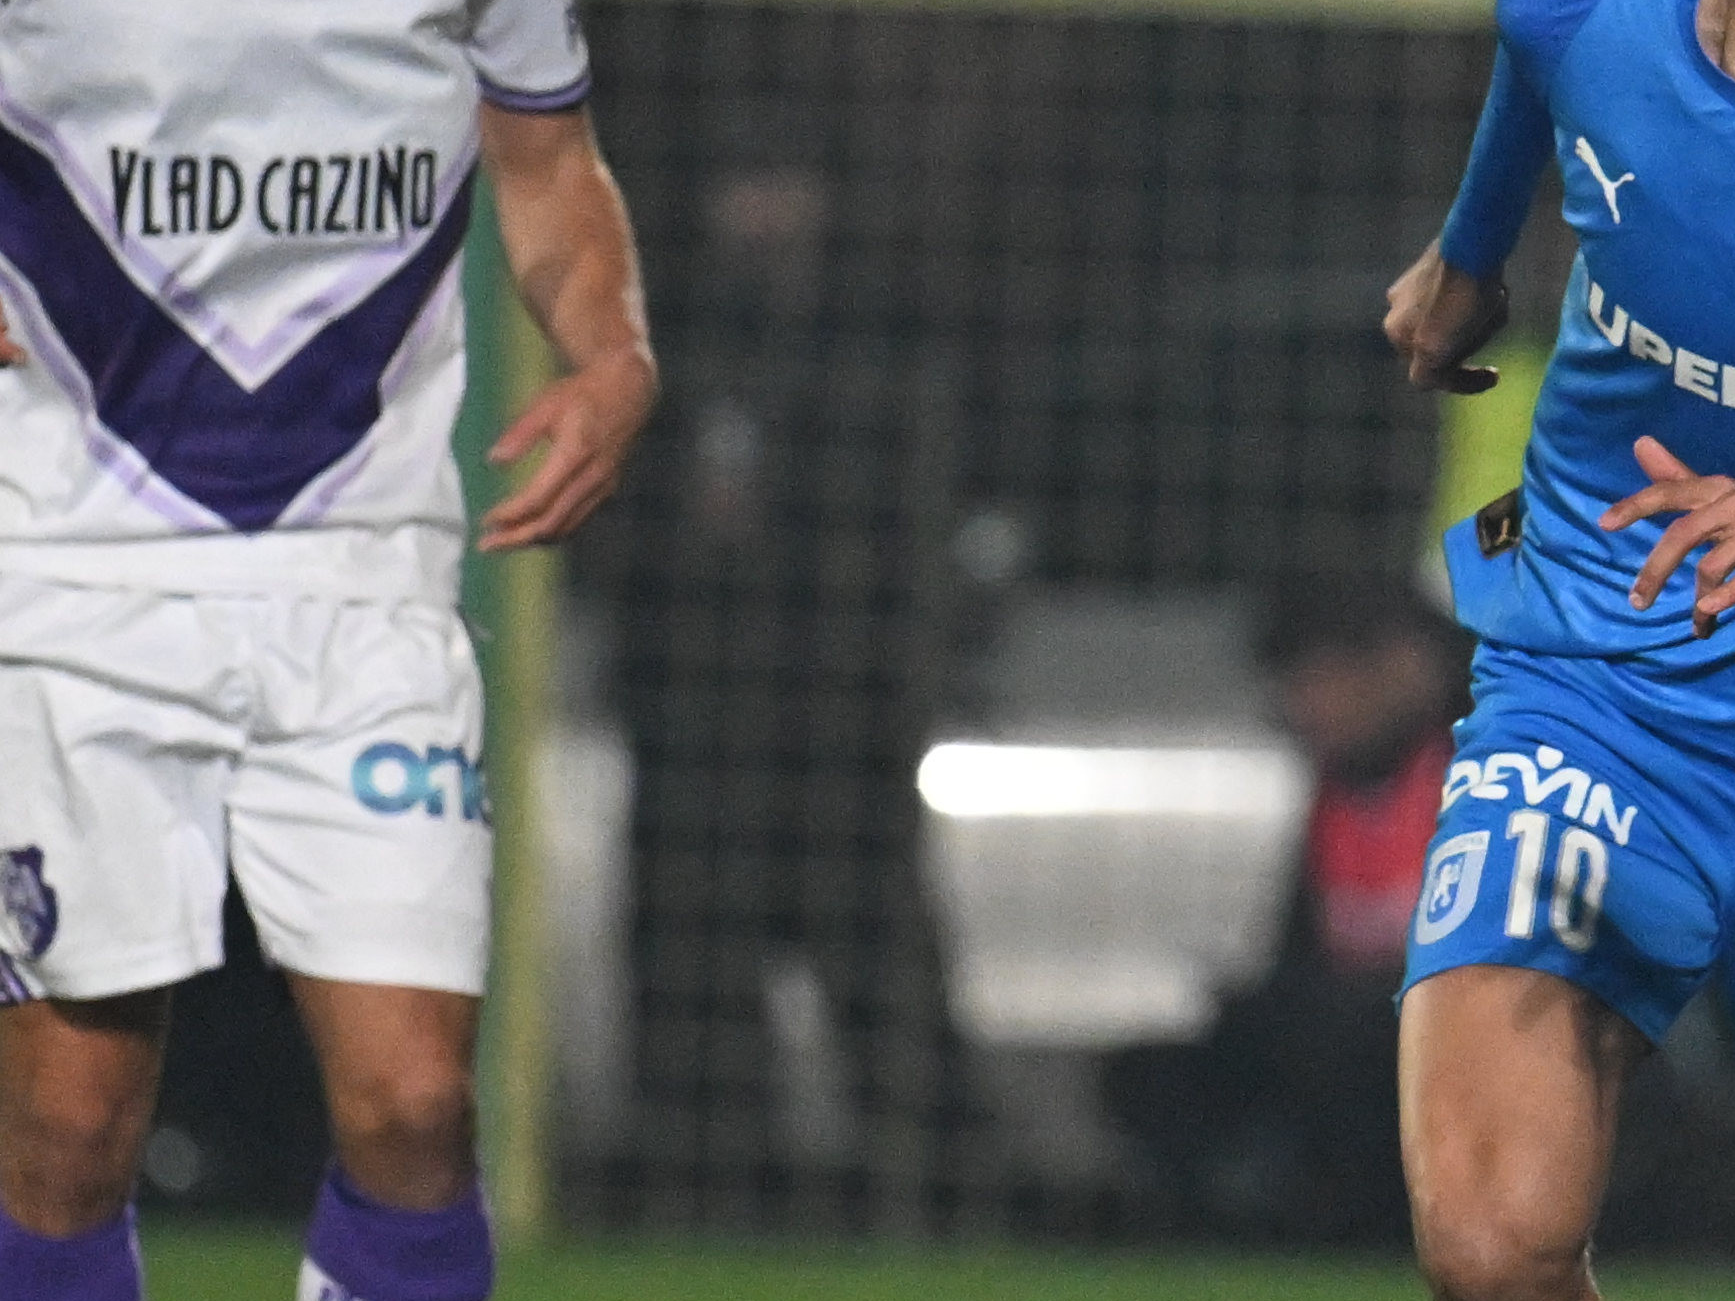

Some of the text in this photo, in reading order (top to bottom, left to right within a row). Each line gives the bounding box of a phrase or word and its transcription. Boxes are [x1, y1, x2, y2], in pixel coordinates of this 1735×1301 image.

[109, 143, 438, 241] VLAD CAZINO
[351, 741, 490, 825] on
[1504, 809, 1609, 954] 10
